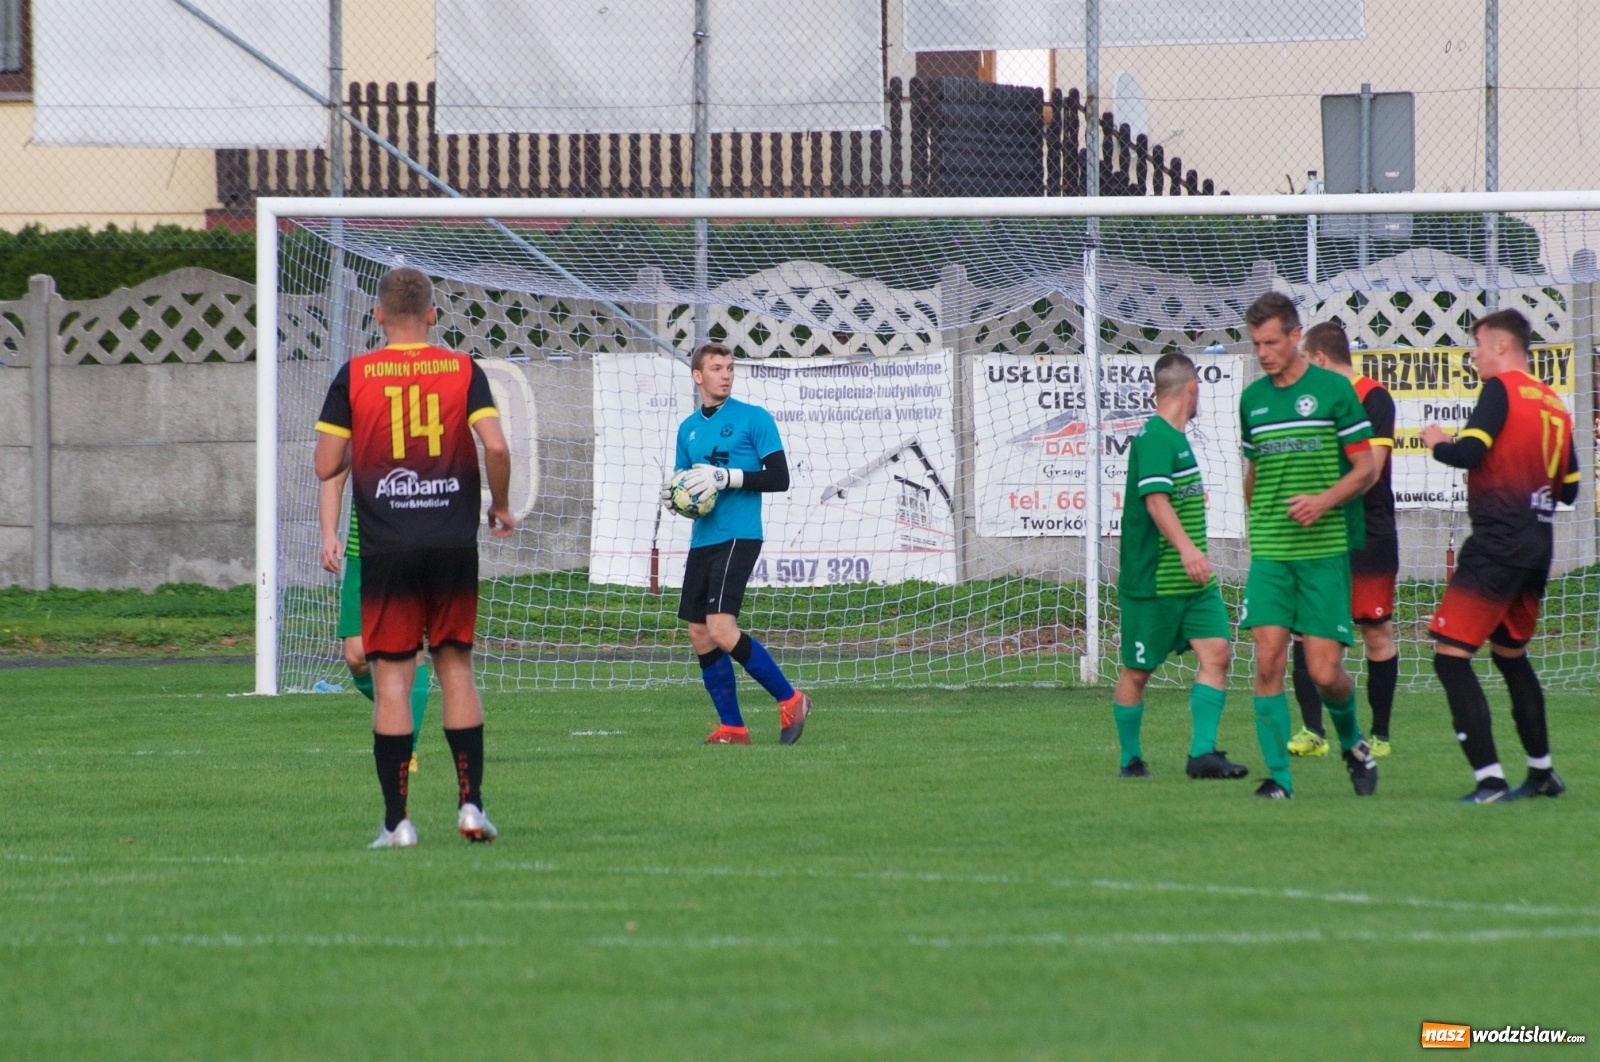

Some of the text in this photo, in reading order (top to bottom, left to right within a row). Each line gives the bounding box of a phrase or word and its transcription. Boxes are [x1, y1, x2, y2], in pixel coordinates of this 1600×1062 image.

[413, 359, 460, 376] POŁOMIA
[988, 365, 1079, 383] USŁUGI
[799, 383, 943, 401] Docieplenia budynków
[770, 406, 944, 424] sowe wykończenia wnętrz
[1424, 404, 1473, 420] Produ
[384, 384, 444, 459] 14
[1540, 408, 1564, 479] 17
[1043, 464, 1086, 478] Grzego
[375, 468, 460, 498] Alabama
[390, 499, 450, 509] Tour&Holiday
[1008, 491, 1047, 510] tel.
[1057, 491, 1086, 510] 66
[1392, 491, 1448, 502] kowice,
[752, 557, 869, 583] 4 507 320
[1135, 641, 1146, 664] 2
